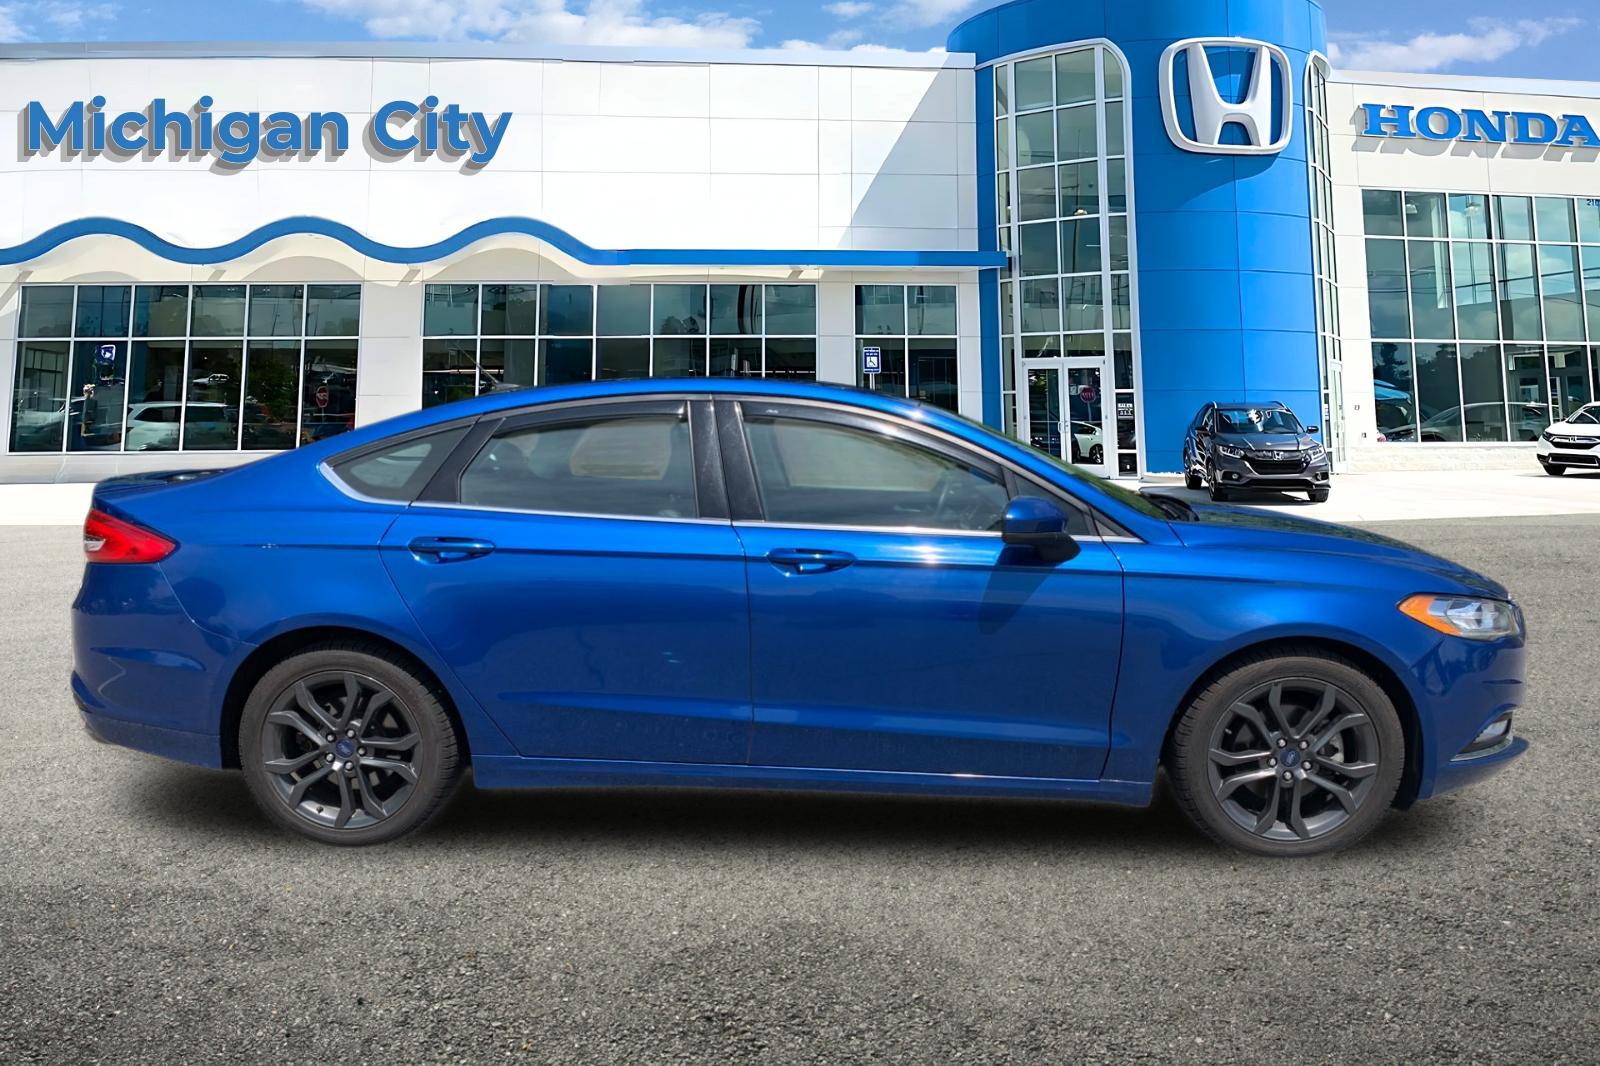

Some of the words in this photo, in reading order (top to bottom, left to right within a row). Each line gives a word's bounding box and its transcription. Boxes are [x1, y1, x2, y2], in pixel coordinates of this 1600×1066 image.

[28, 95, 349, 163] Michigan
[374, 95, 512, 163] City
[1362, 103, 1600, 147] HONDA
